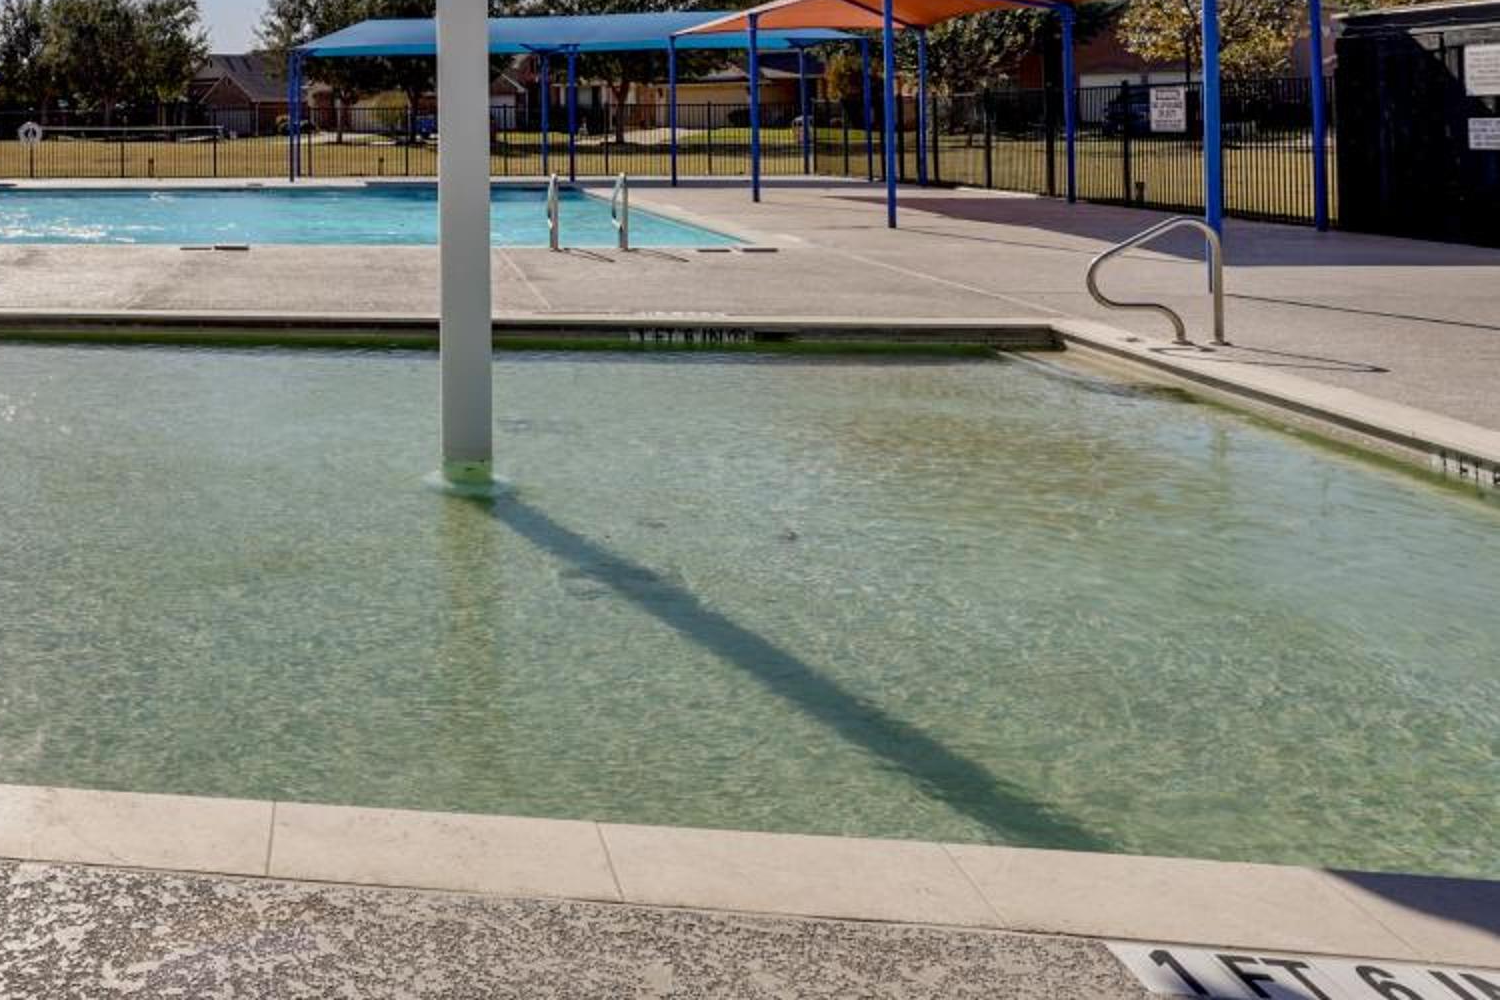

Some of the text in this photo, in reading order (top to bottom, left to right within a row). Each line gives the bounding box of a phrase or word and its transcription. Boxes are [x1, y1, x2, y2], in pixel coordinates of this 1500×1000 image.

[1148, 949, 1211, 997] 1
[1215, 954, 1332, 1000] FT
[1355, 965, 1424, 1000] 6
